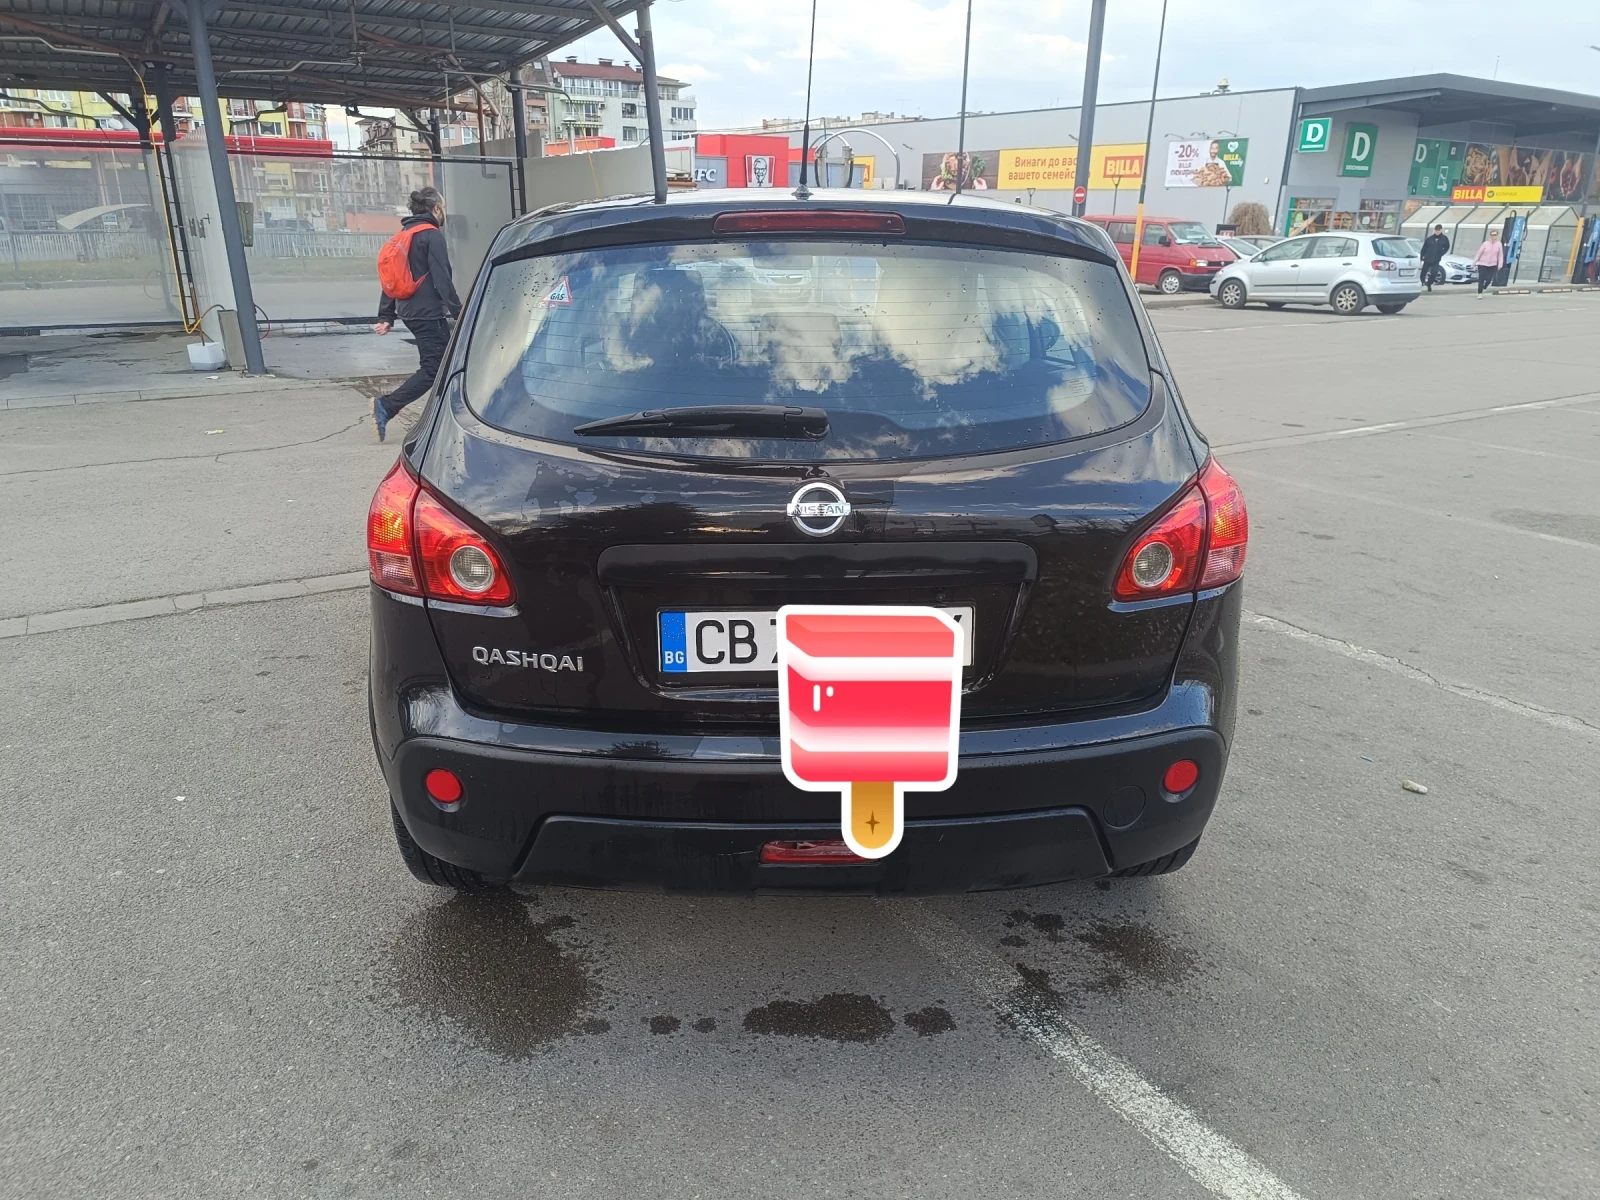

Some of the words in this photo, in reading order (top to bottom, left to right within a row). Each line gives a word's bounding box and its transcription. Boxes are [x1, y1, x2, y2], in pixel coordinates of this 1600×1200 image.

[1306, 123, 1324, 143] D
[1175, 144, 1199, 158] -20%
[1351, 131, 1371, 162] D
[1014, 156, 1047, 168] Винаги
[1048, 157, 1060, 168] до
[1106, 158, 1141, 176] BILLA
[1008, 170, 1041, 181] вашето
[1452, 189, 1484, 200] BILLA
[550, 292, 565, 301] GAS
[795, 504, 845, 515] NISSAN
[472, 646, 584, 673] QASHQAI
[664, 650, 685, 665] BG
